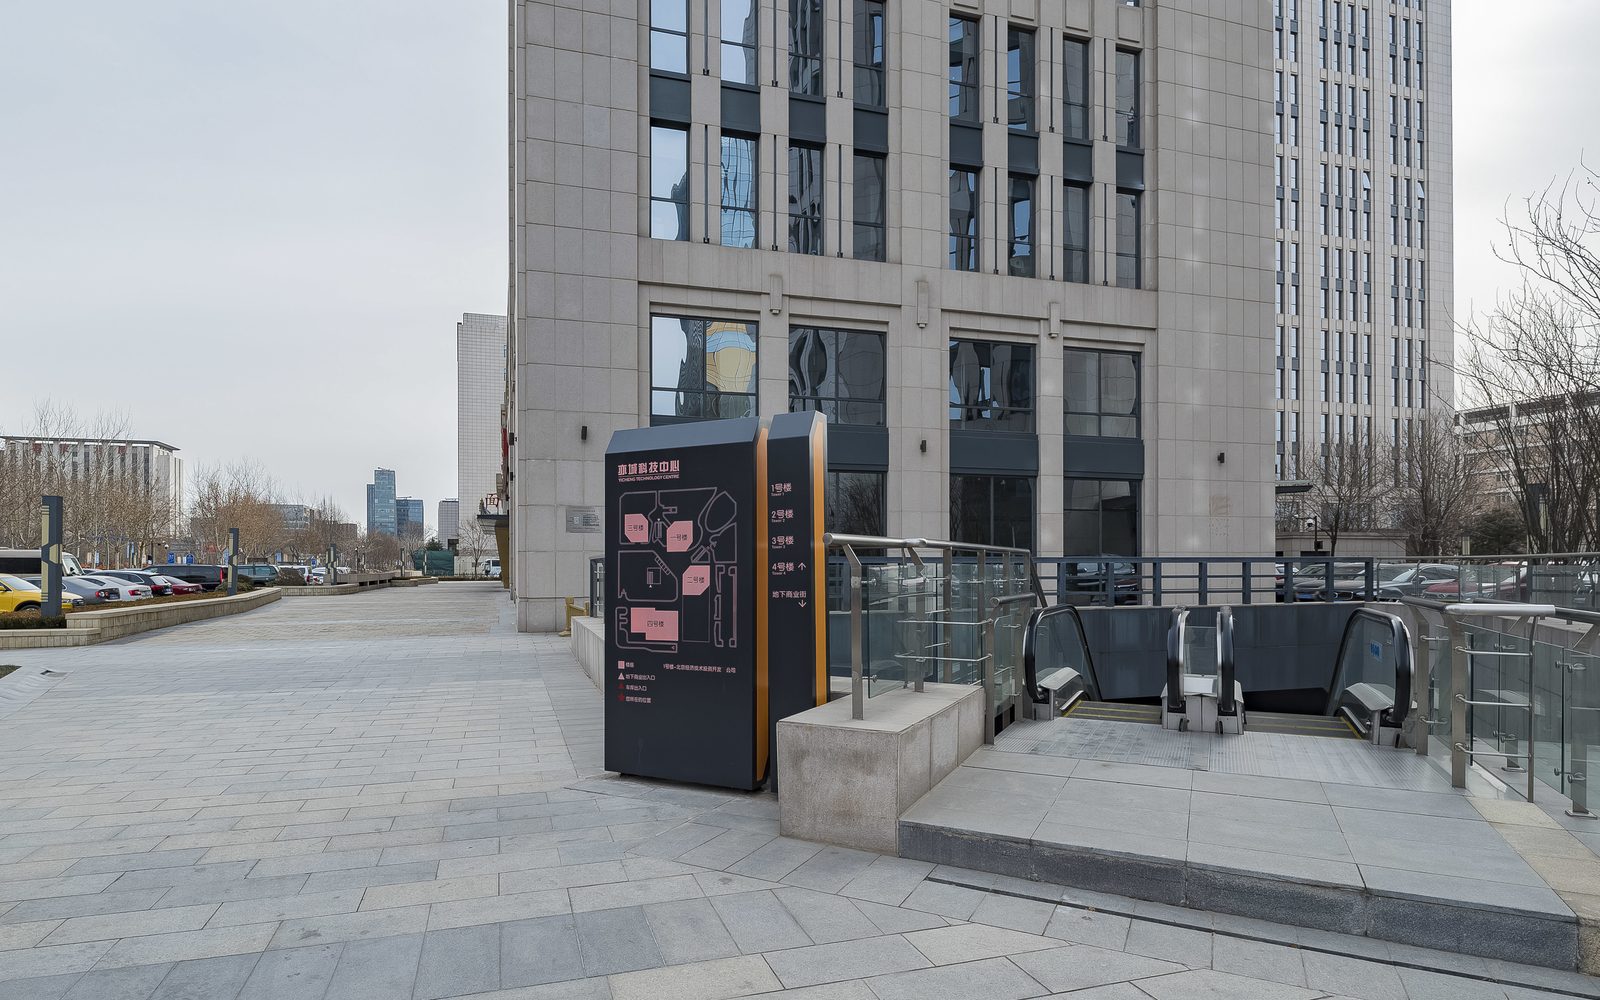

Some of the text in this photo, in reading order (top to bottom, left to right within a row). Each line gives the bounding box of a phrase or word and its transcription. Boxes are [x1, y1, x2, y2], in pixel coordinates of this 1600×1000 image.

[618, 460, 680, 476] 亦城科技中心
[770, 482, 792, 493] 1号楼
[771, 509, 794, 519] 2号楼
[771, 535, 794, 545] 3号楼
[772, 562, 794, 572] 4号楼
[772, 590, 807, 598] 地下商业街
